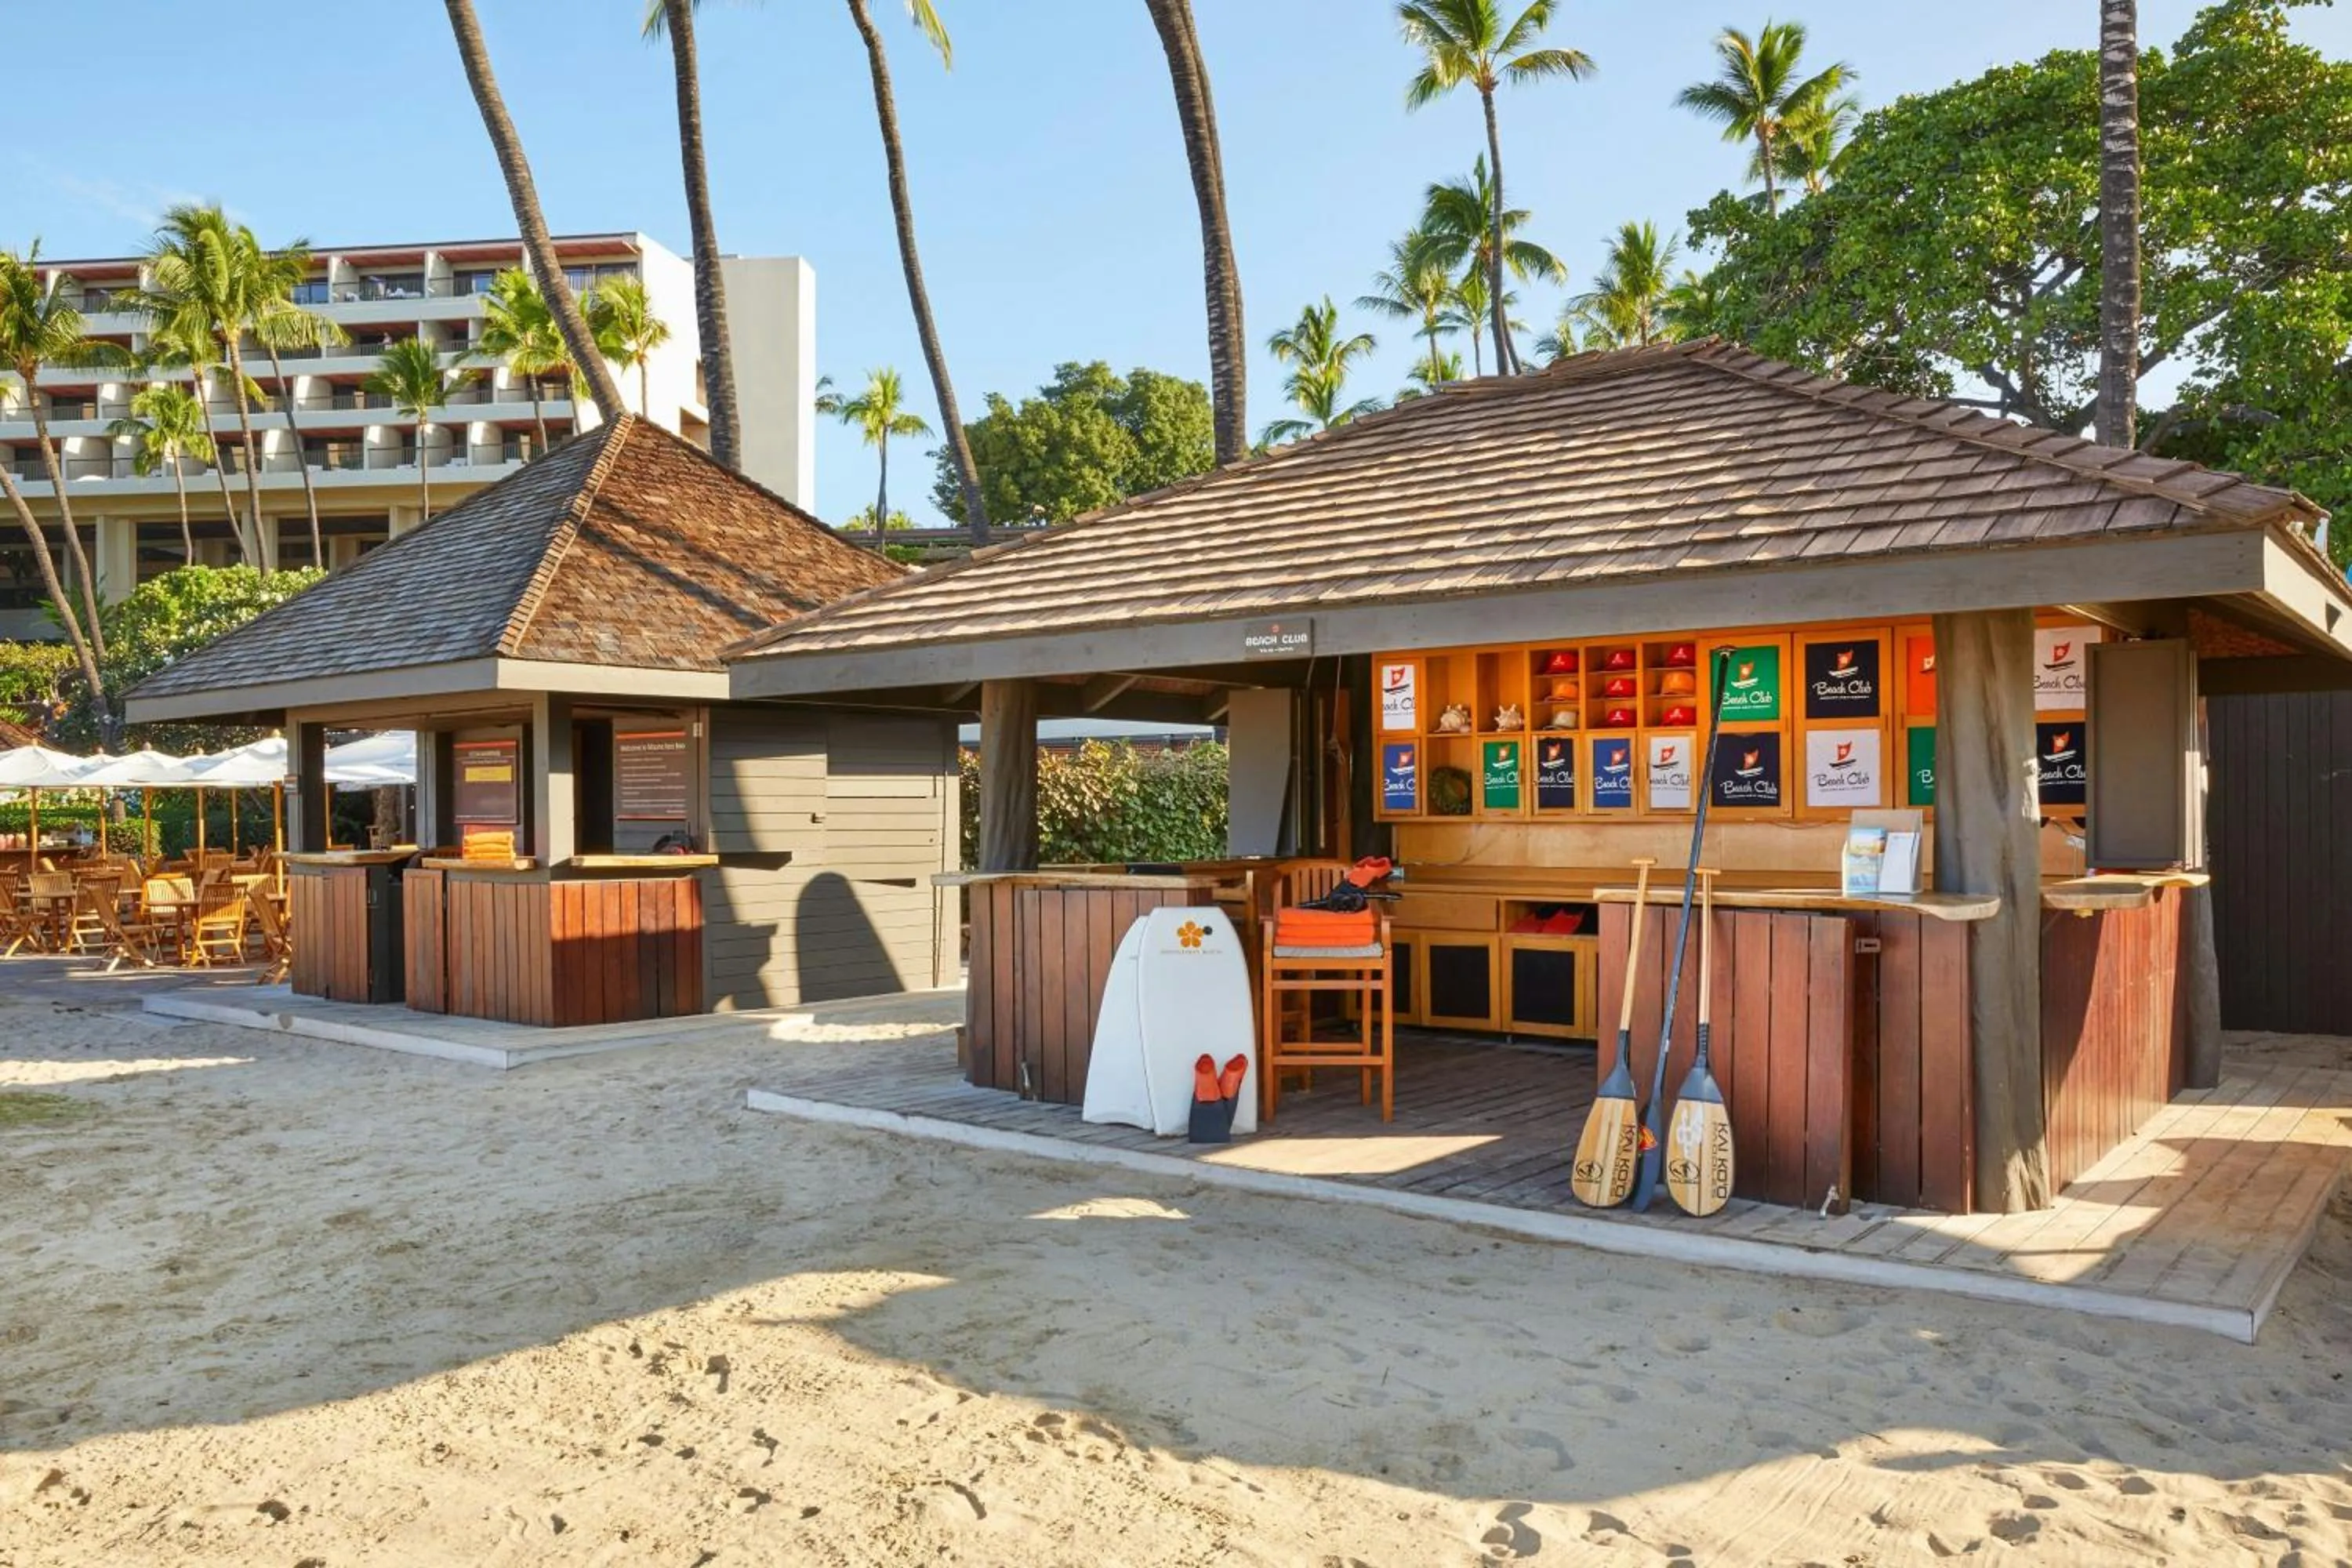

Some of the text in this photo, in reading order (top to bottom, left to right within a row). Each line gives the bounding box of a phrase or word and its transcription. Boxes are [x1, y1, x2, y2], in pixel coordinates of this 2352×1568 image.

[1245, 633, 1308, 647] BEACH CLUB
[1812, 680, 1872, 695] Beach Club
[1749, 691, 1773, 703] Club
[1813, 771, 1870, 786] Beach Club
[2065, 764, 2086, 779] Clu
[1719, 780, 1778, 794] Beach Club
[1624, 1124, 1636, 1152] KAI
[1717, 1123, 1730, 1152] KAI
